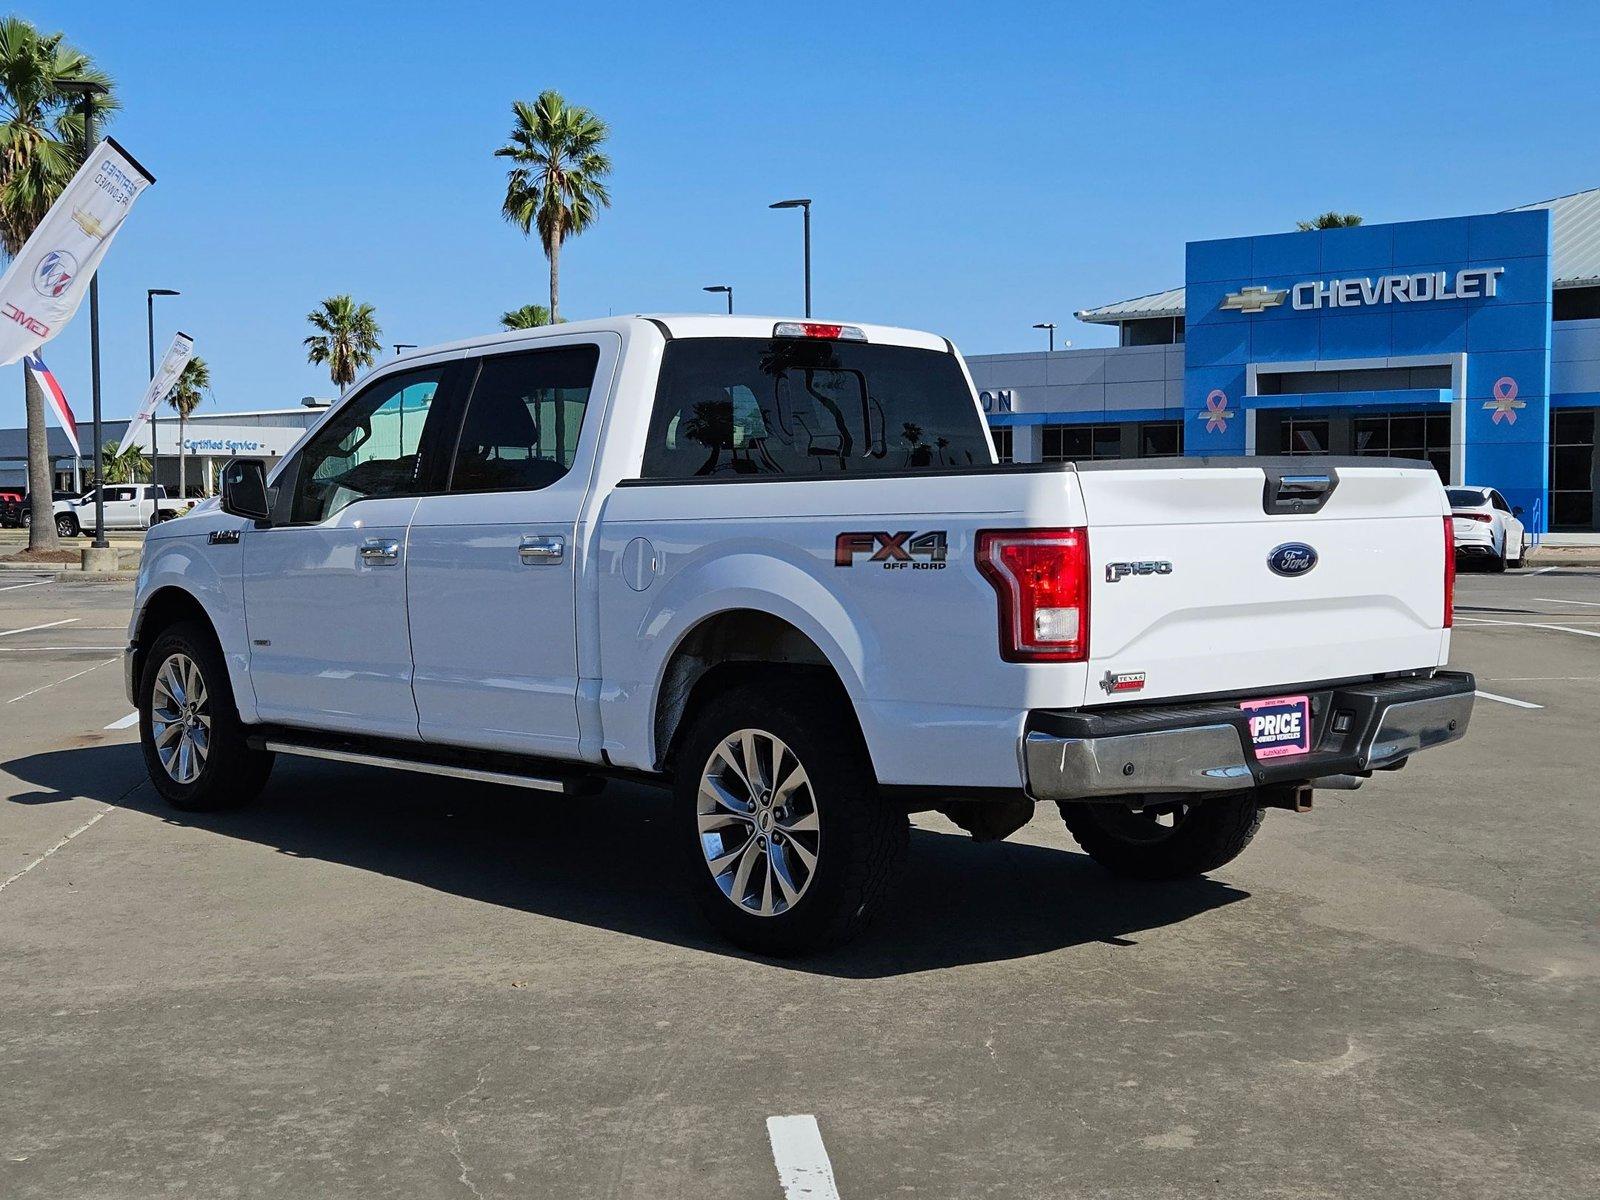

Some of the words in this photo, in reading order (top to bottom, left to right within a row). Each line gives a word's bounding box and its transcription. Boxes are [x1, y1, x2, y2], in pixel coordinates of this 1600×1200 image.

[1292, 266, 1504, 311] CHEVROLET
[183, 439, 223, 450] Certified
[225, 440, 258, 451] Service
[835, 530, 948, 568] FX4
[883, 562, 908, 570] OFF
[912, 562, 947, 570] ROAD
[1281, 550, 1310, 570] Ford
[1119, 674, 1143, 682] TEXAS
